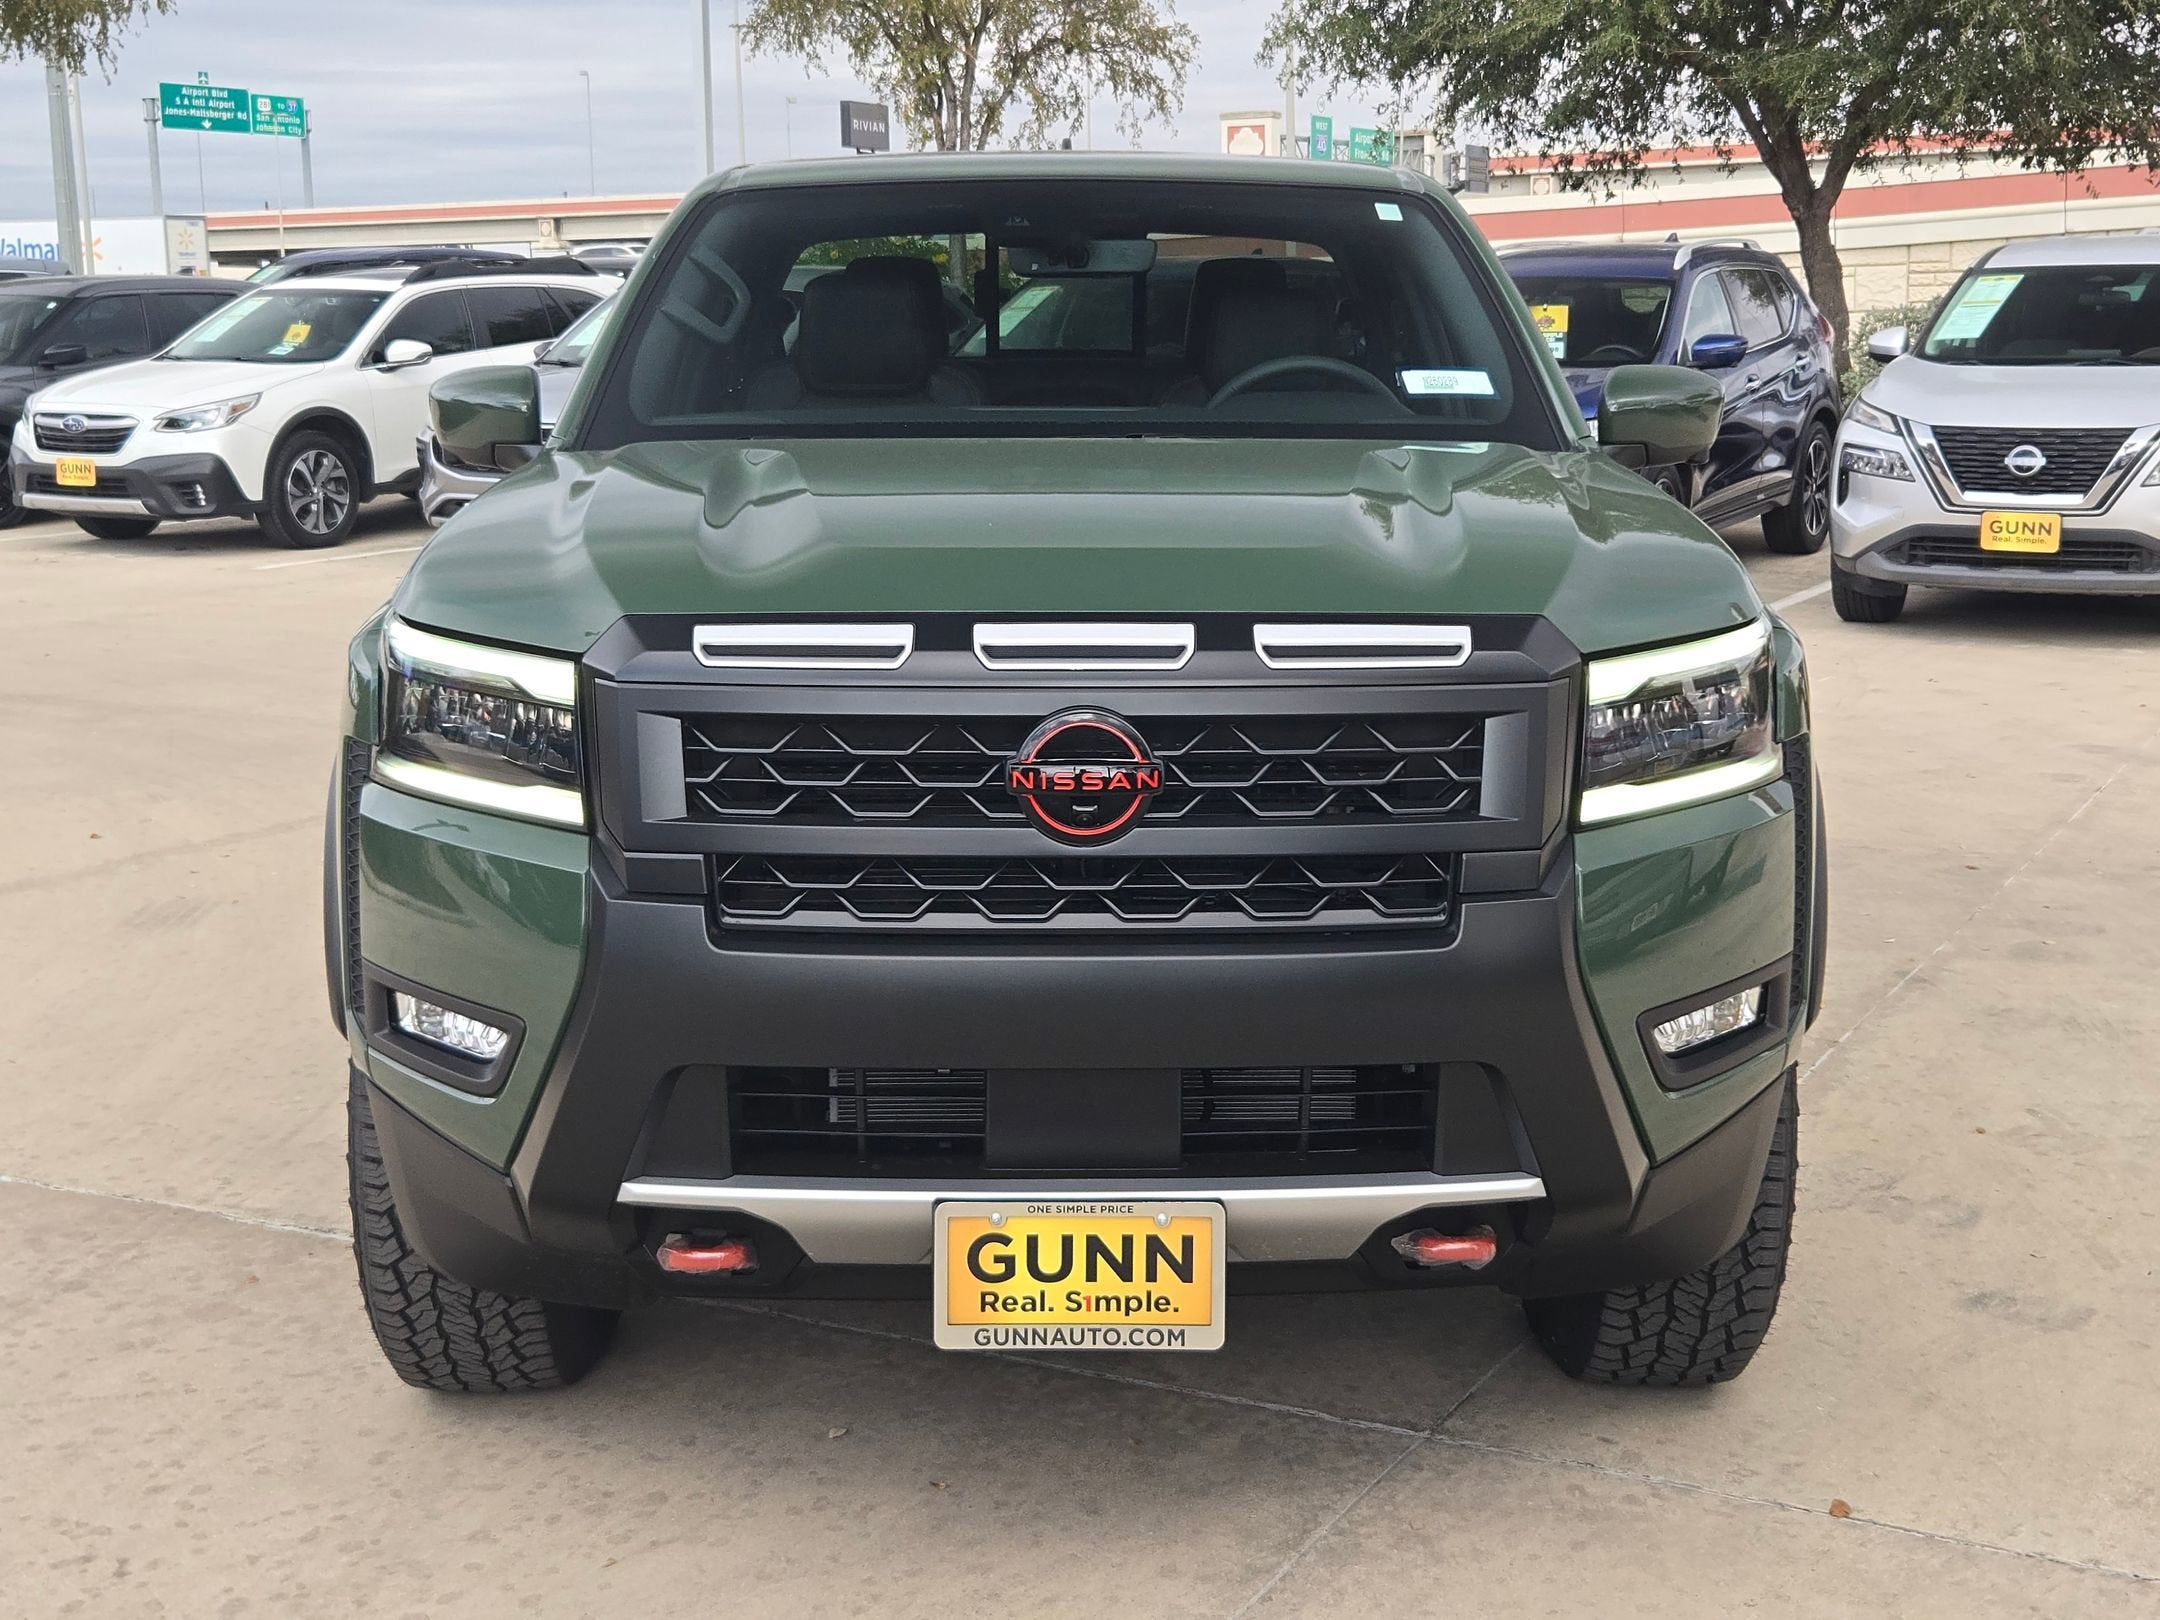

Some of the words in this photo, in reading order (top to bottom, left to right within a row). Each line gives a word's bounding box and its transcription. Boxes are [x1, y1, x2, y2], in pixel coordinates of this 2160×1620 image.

[181, 86, 209, 97] Airport
[211, 89, 228, 98] Blvd
[175, 97, 181, 105] S
[183, 98, 189, 106] A
[208, 100, 235, 109] Airport
[237, 111, 247, 120] Rd
[256, 113, 270, 122] San
[288, 126, 302, 136] City
[853, 119, 885, 133] RIVIAN
[0, 238, 60, 262] alma
[60, 463, 91, 474] GUNN
[1989, 520, 2052, 536] GUNN
[1011, 770, 1159, 791] NISSAN
[1027, 1205, 1052, 1214] ONE
[1056, 1205, 1097, 1214] SIMPLE
[1100, 1205, 1134, 1214] PRICE
[967, 1232, 1194, 1284] GUNN
[980, 1290, 1054, 1313] Real.
[974, 1328, 1186, 1347] GUNNAUTO.COM
